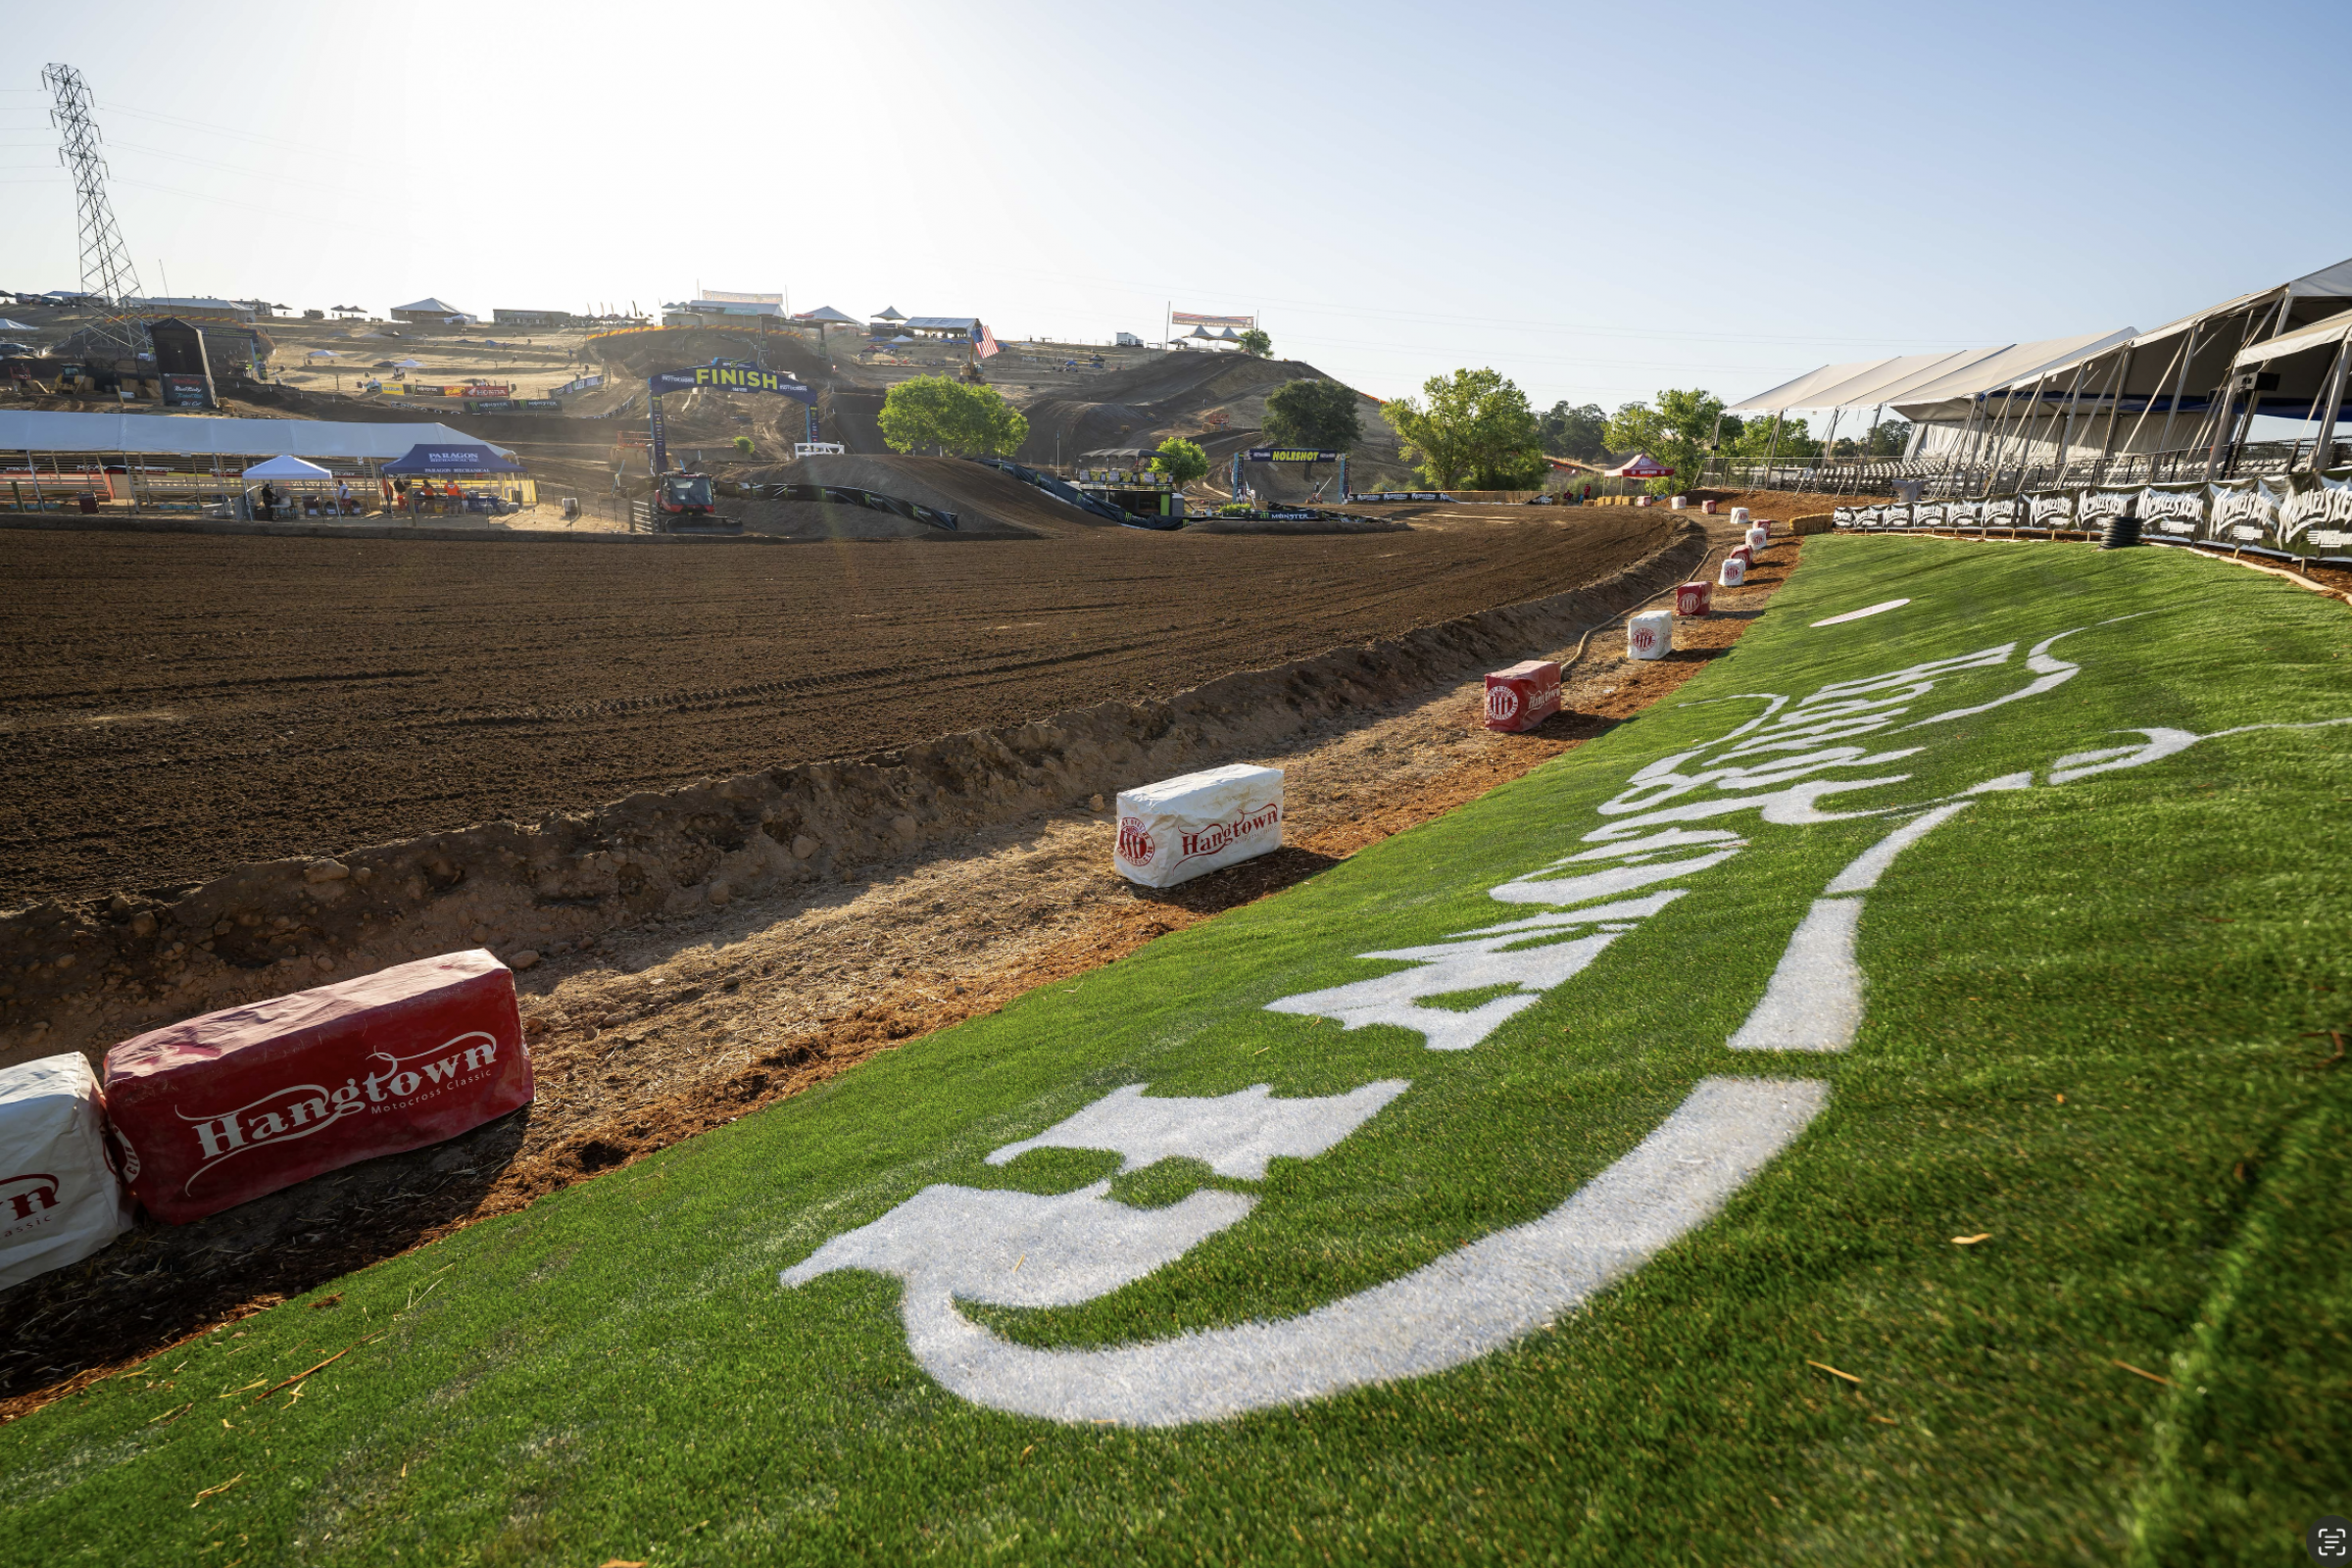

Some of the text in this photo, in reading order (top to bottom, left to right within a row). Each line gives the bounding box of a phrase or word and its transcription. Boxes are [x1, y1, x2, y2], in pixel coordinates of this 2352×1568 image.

[696, 368, 778, 390] FINISH
[1272, 451, 1319, 461] HOLESHOT
[1175, 804, 1278, 868] Hangtown
[178, 1031, 497, 1184] Hangtown
[370, 1069, 491, 1115] Motocross Classic
[4, 1214, 52, 1238] assic
